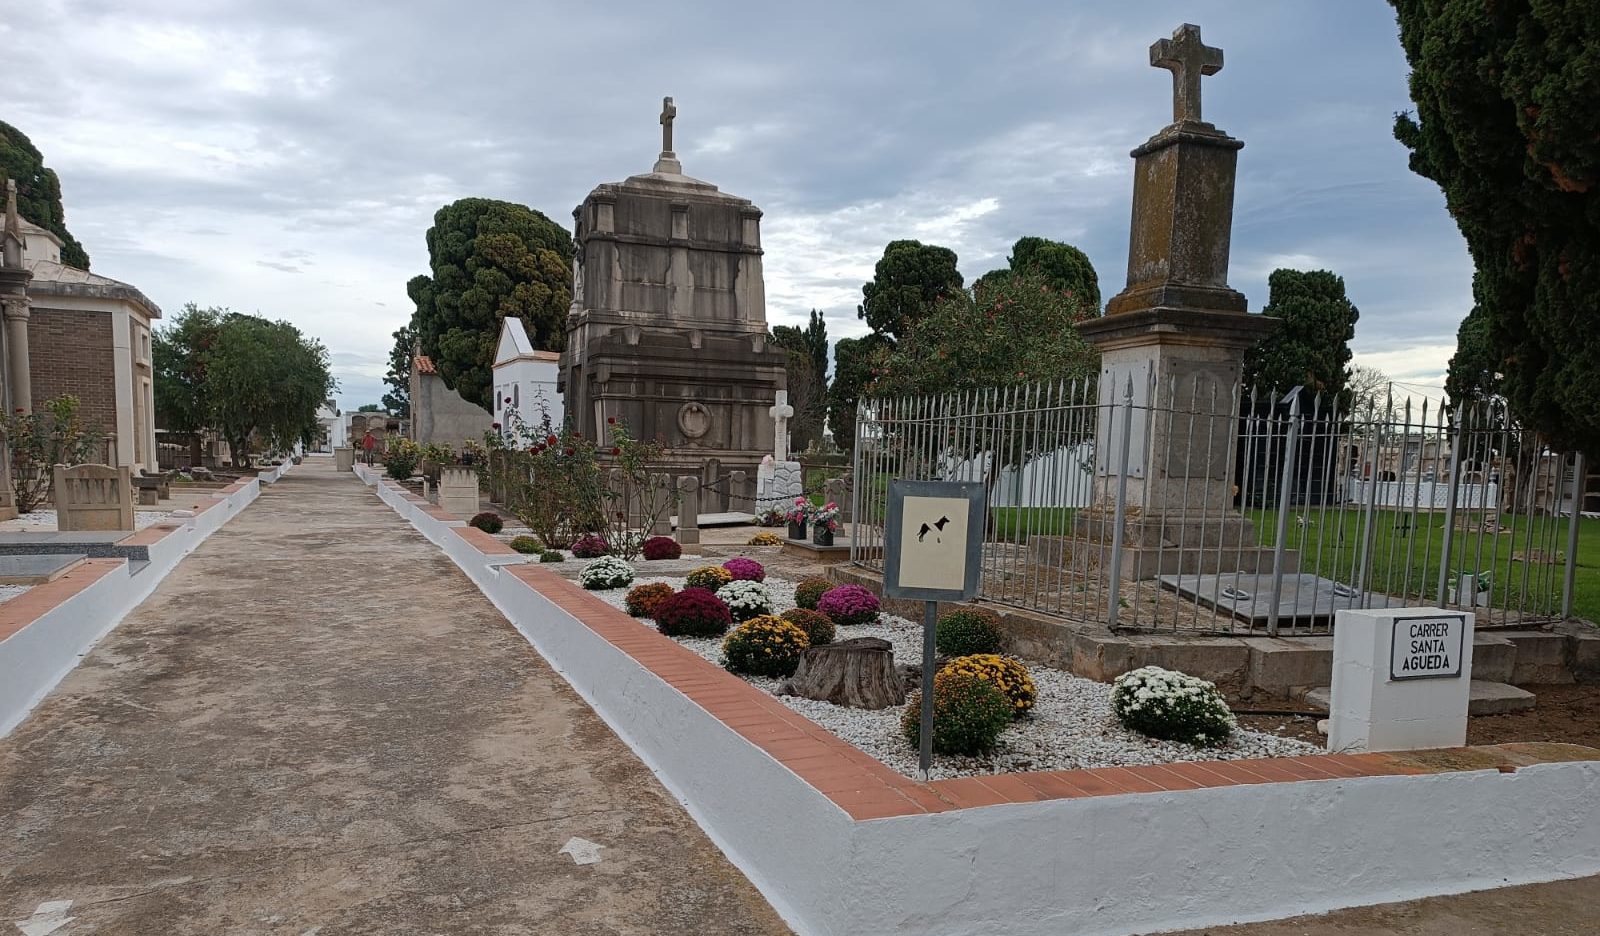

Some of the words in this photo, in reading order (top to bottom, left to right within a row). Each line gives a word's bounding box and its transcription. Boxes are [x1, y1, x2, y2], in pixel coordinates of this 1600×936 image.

[1410, 623, 1449, 638] CARRER
[1410, 640, 1446, 654] SANTA
[1402, 655, 1450, 671] AGUEDA
